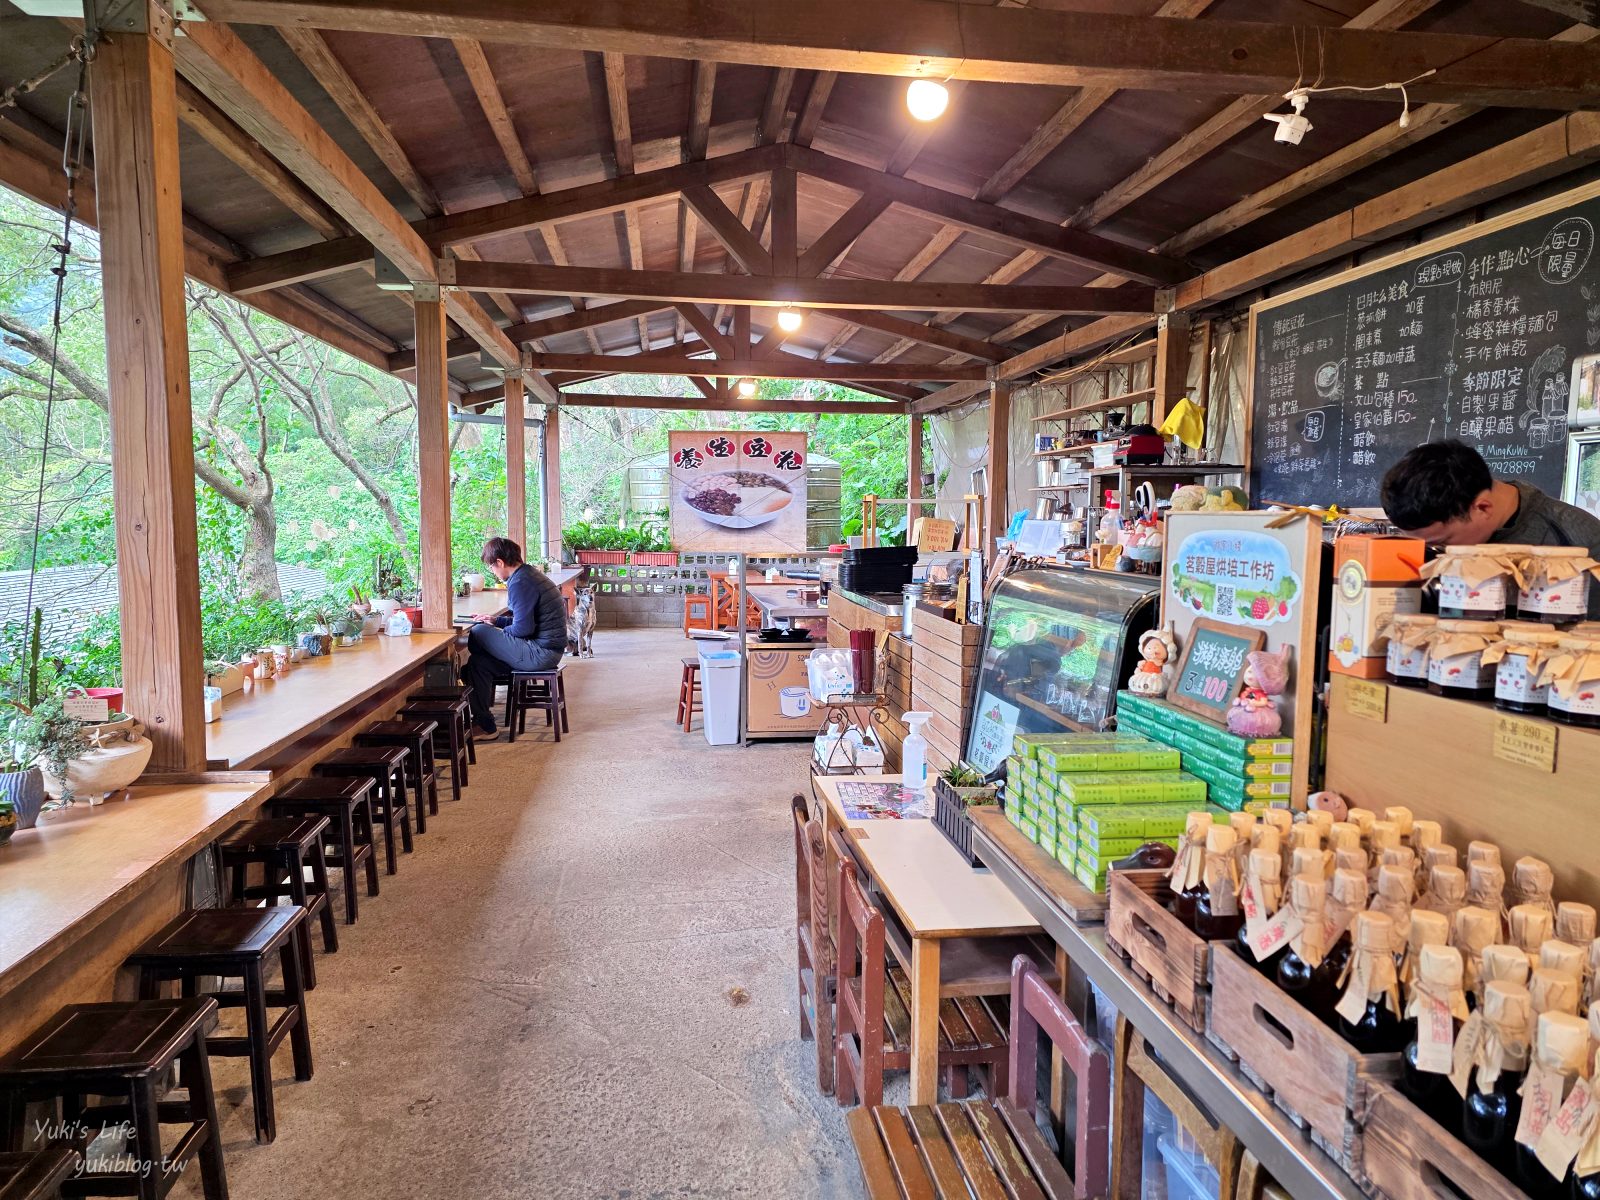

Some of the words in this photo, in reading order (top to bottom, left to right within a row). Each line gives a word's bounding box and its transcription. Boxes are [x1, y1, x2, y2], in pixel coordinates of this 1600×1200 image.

[1552, 231, 1580, 250] 每日
[1468, 246, 1530, 281] 手作點心
[1548, 251, 1576, 278] 限量
[1467, 278, 1502, 298] 布朗尼
[1406, 296, 1426, 314] 加蛋
[1464, 339, 1528, 363] 手作餅乾
[1463, 367, 1523, 392] 季節限定
[1202, 676, 1228, 703] 100
